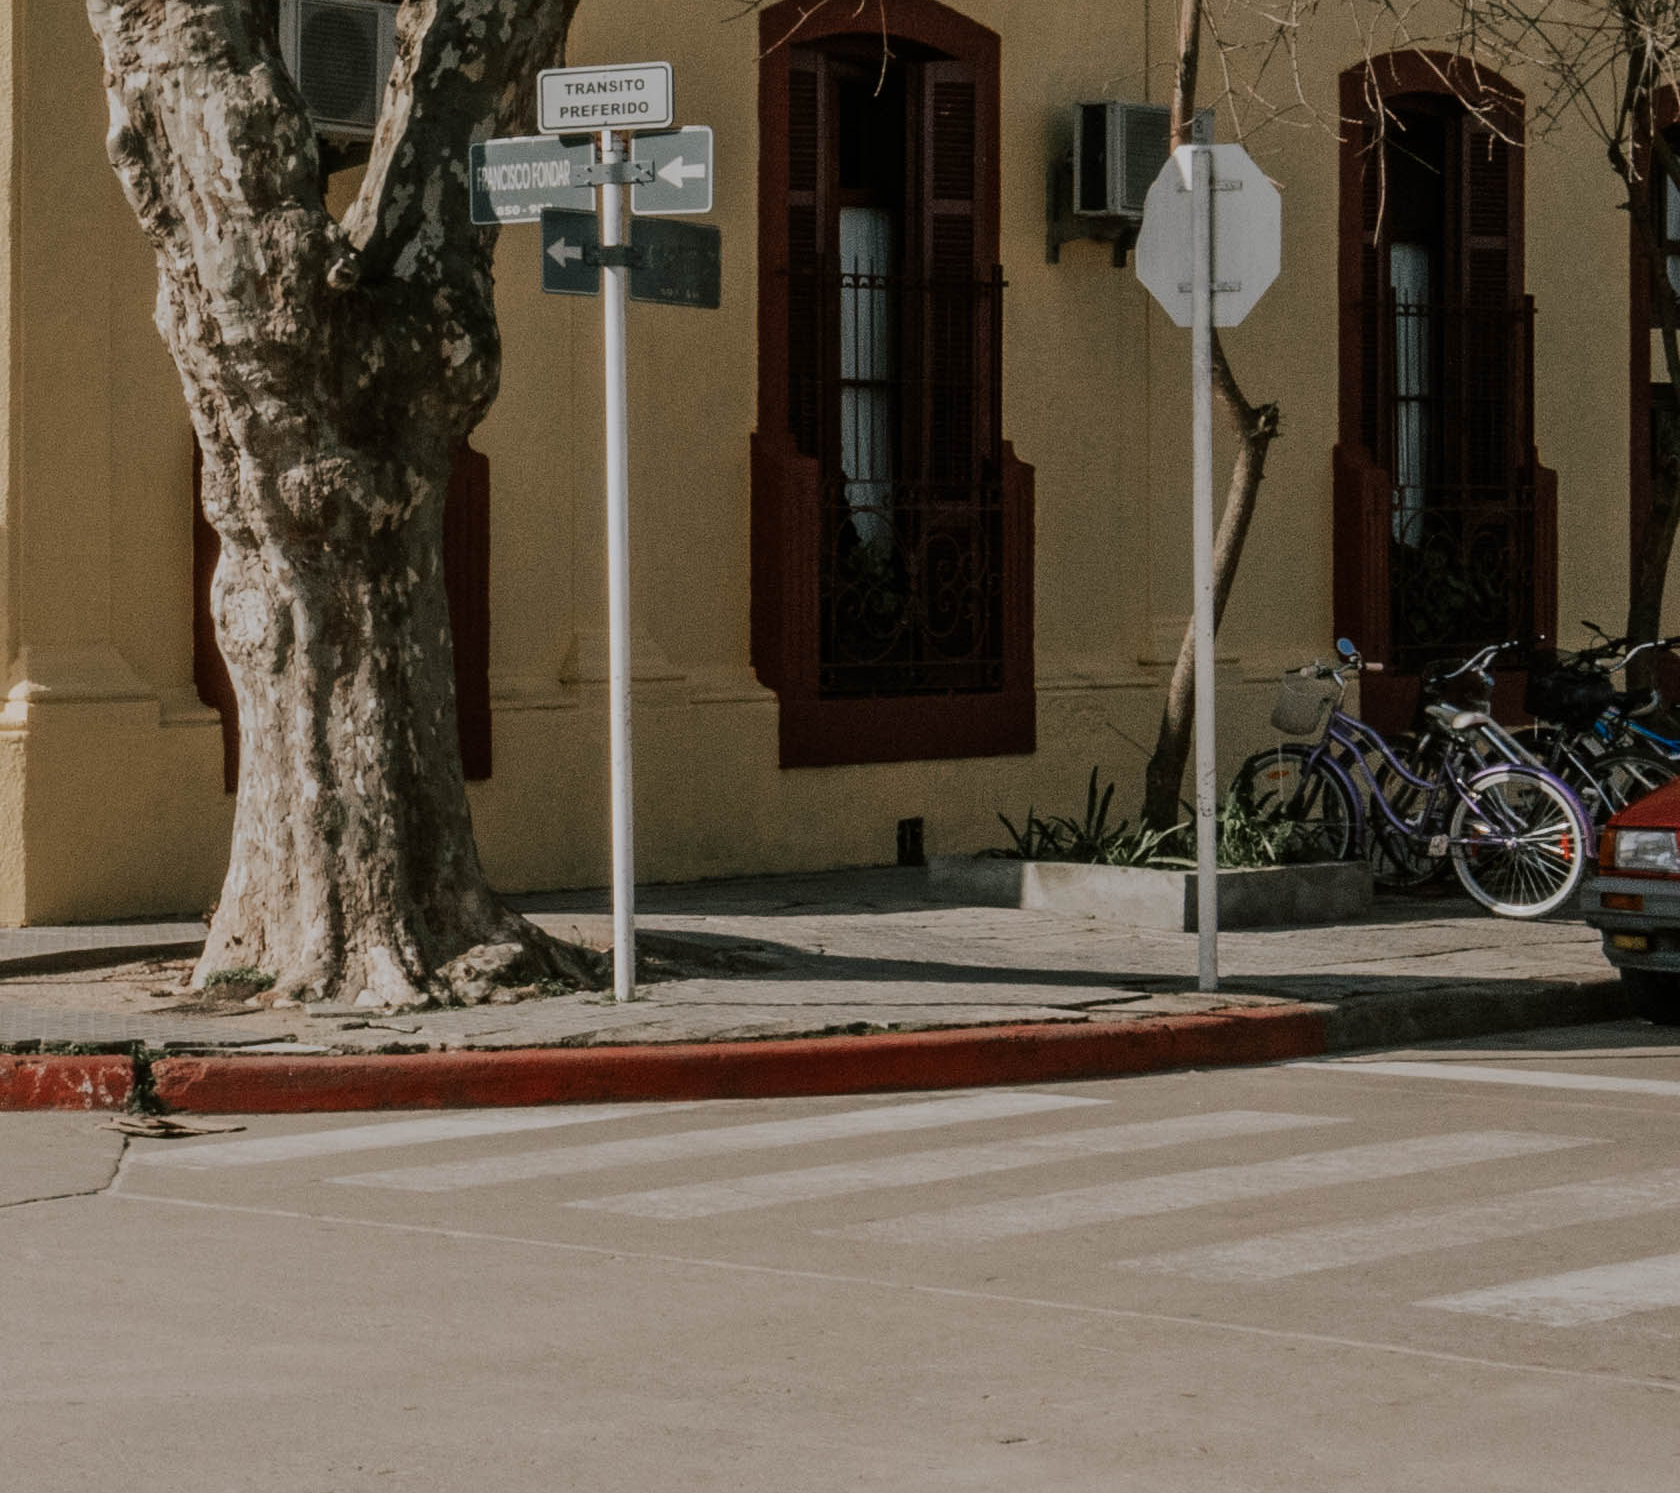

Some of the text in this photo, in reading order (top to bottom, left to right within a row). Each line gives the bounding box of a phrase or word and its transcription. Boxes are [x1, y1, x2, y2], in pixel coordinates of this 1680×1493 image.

[564, 78, 646, 96] TRANSITO
[559, 101, 650, 119] PREFERIDO
[477, 159, 571, 192] FRANCISCO FONDAR
